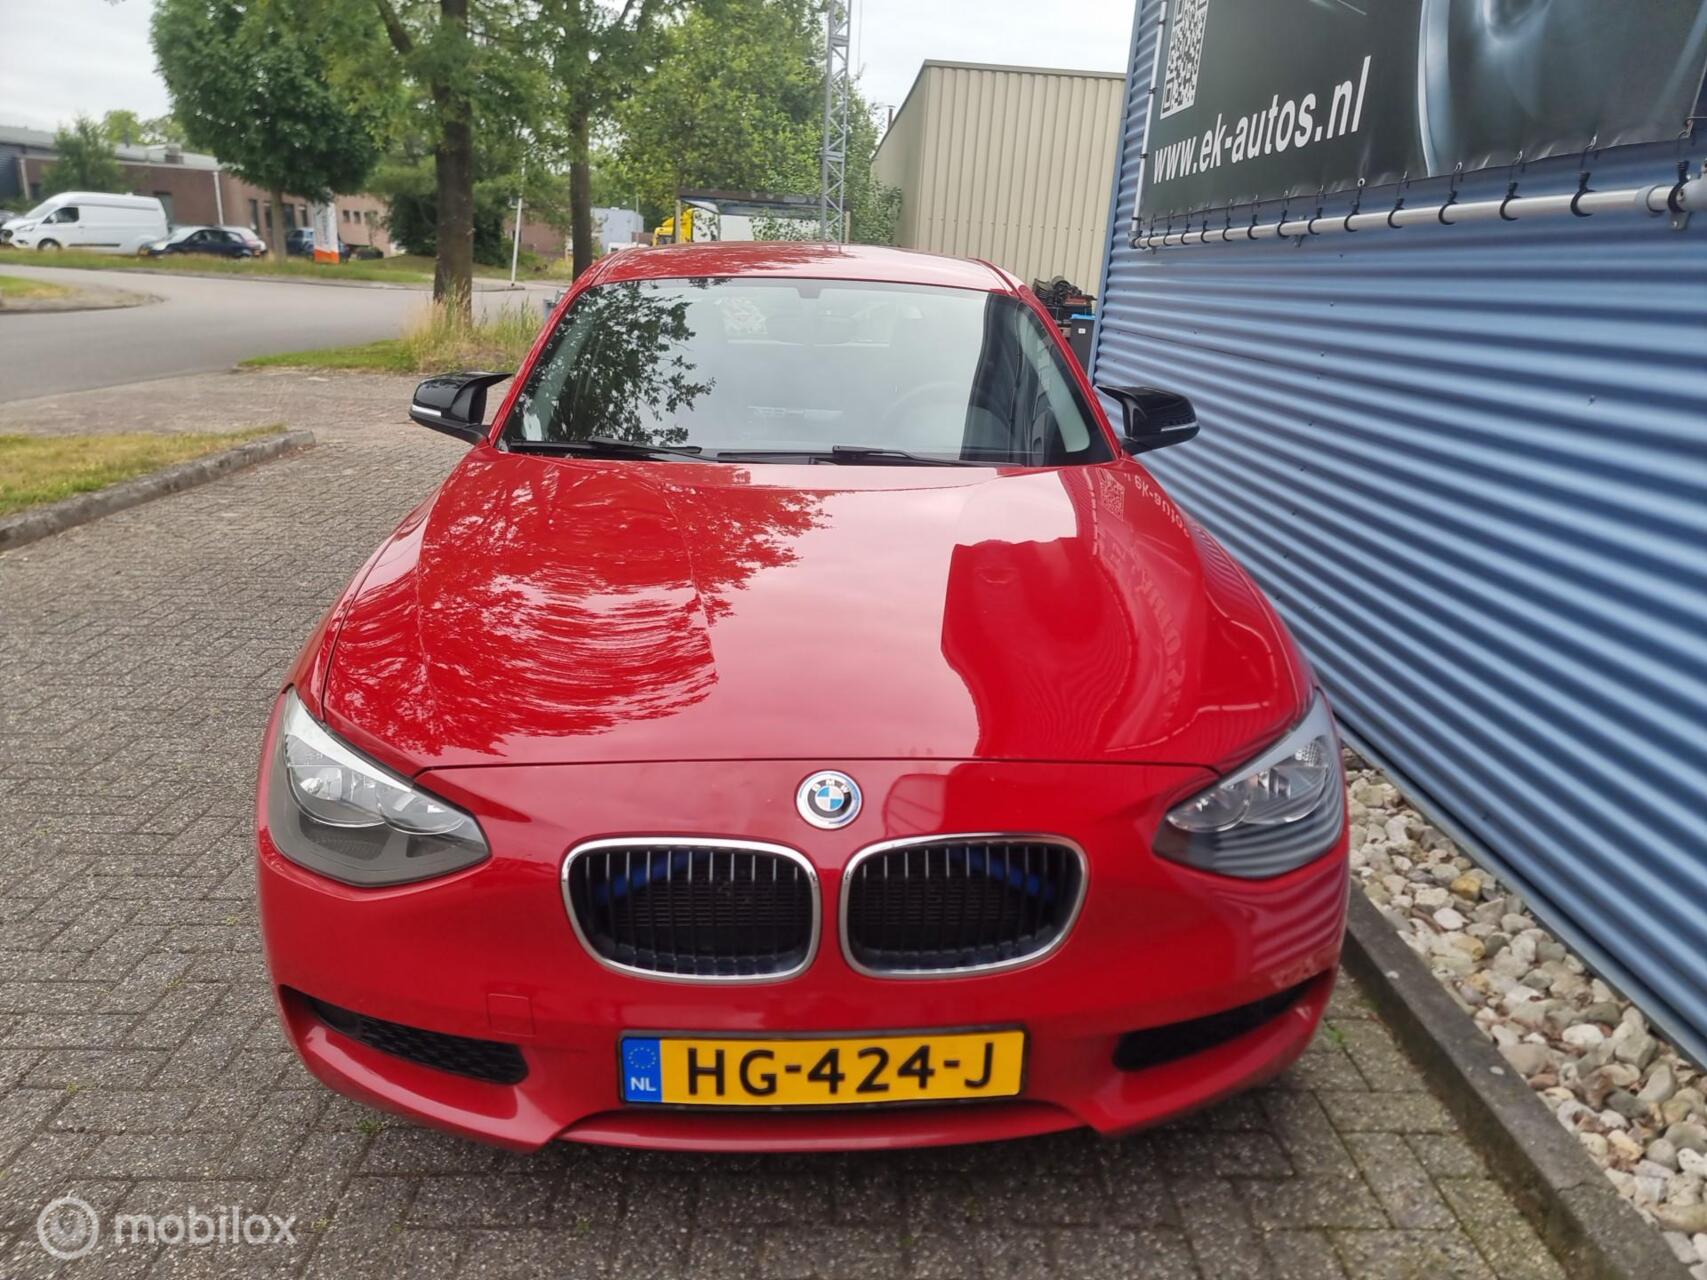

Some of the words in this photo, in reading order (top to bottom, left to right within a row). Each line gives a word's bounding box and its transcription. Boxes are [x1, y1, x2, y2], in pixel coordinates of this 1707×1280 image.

[1153, 55, 1371, 184] www.ek-autos.nl
[812, 779, 850, 793] BMW
[631, 1077, 656, 1091] NL
[687, 1042, 994, 1097] HG-424-J
